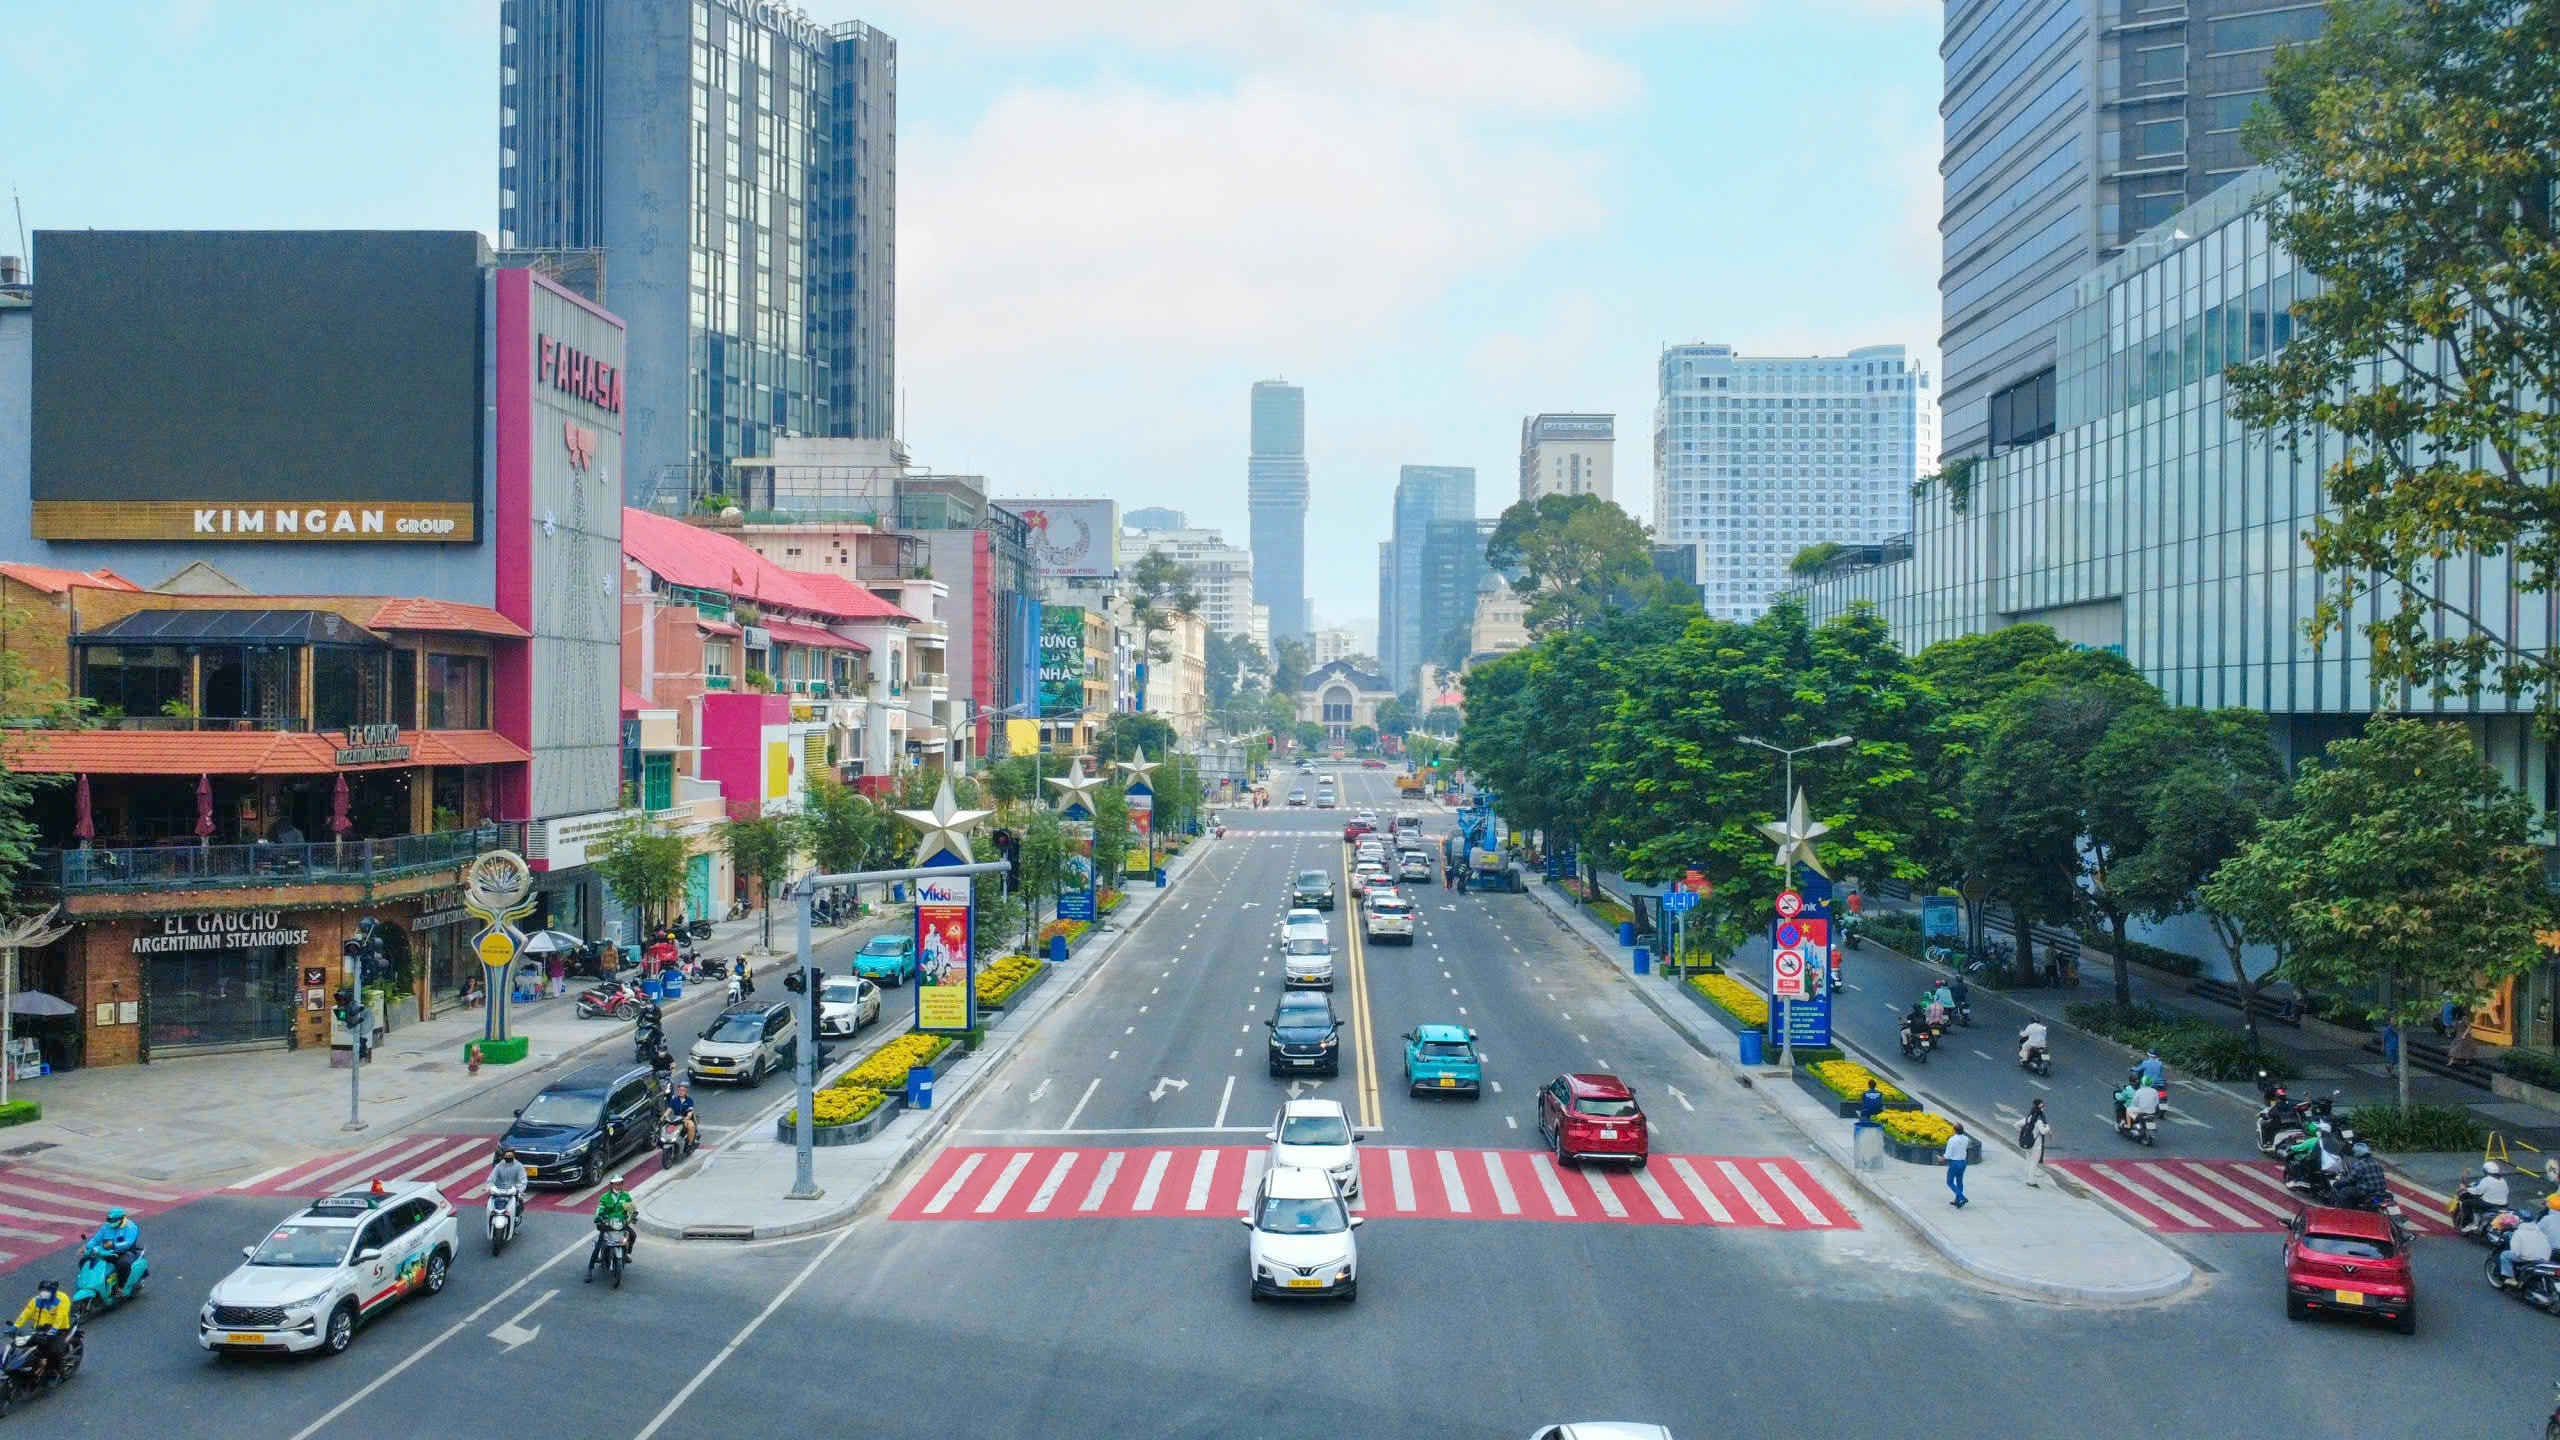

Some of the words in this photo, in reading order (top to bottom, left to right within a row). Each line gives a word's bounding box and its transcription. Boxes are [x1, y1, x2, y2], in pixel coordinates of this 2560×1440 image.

[538, 334, 622, 416] FAHASA
[1545, 423, 1584, 431] CARAVELLE
[1587, 423, 1611, 431] HOTEL
[194, 509, 264, 533] KIM
[275, 509, 384, 533] NGAN
[395, 518, 455, 534] GROUP
[1040, 665, 1072, 680] NHÀ
[364, 723, 400, 745] GAUCHO
[918, 884, 951, 901] Vikki
[164, 914, 189, 935] EL
[197, 911, 279, 933] GAUCHO
[131, 934, 221, 953] ARGENTINIAN
[226, 929, 309, 949] STEAKHOUSE
